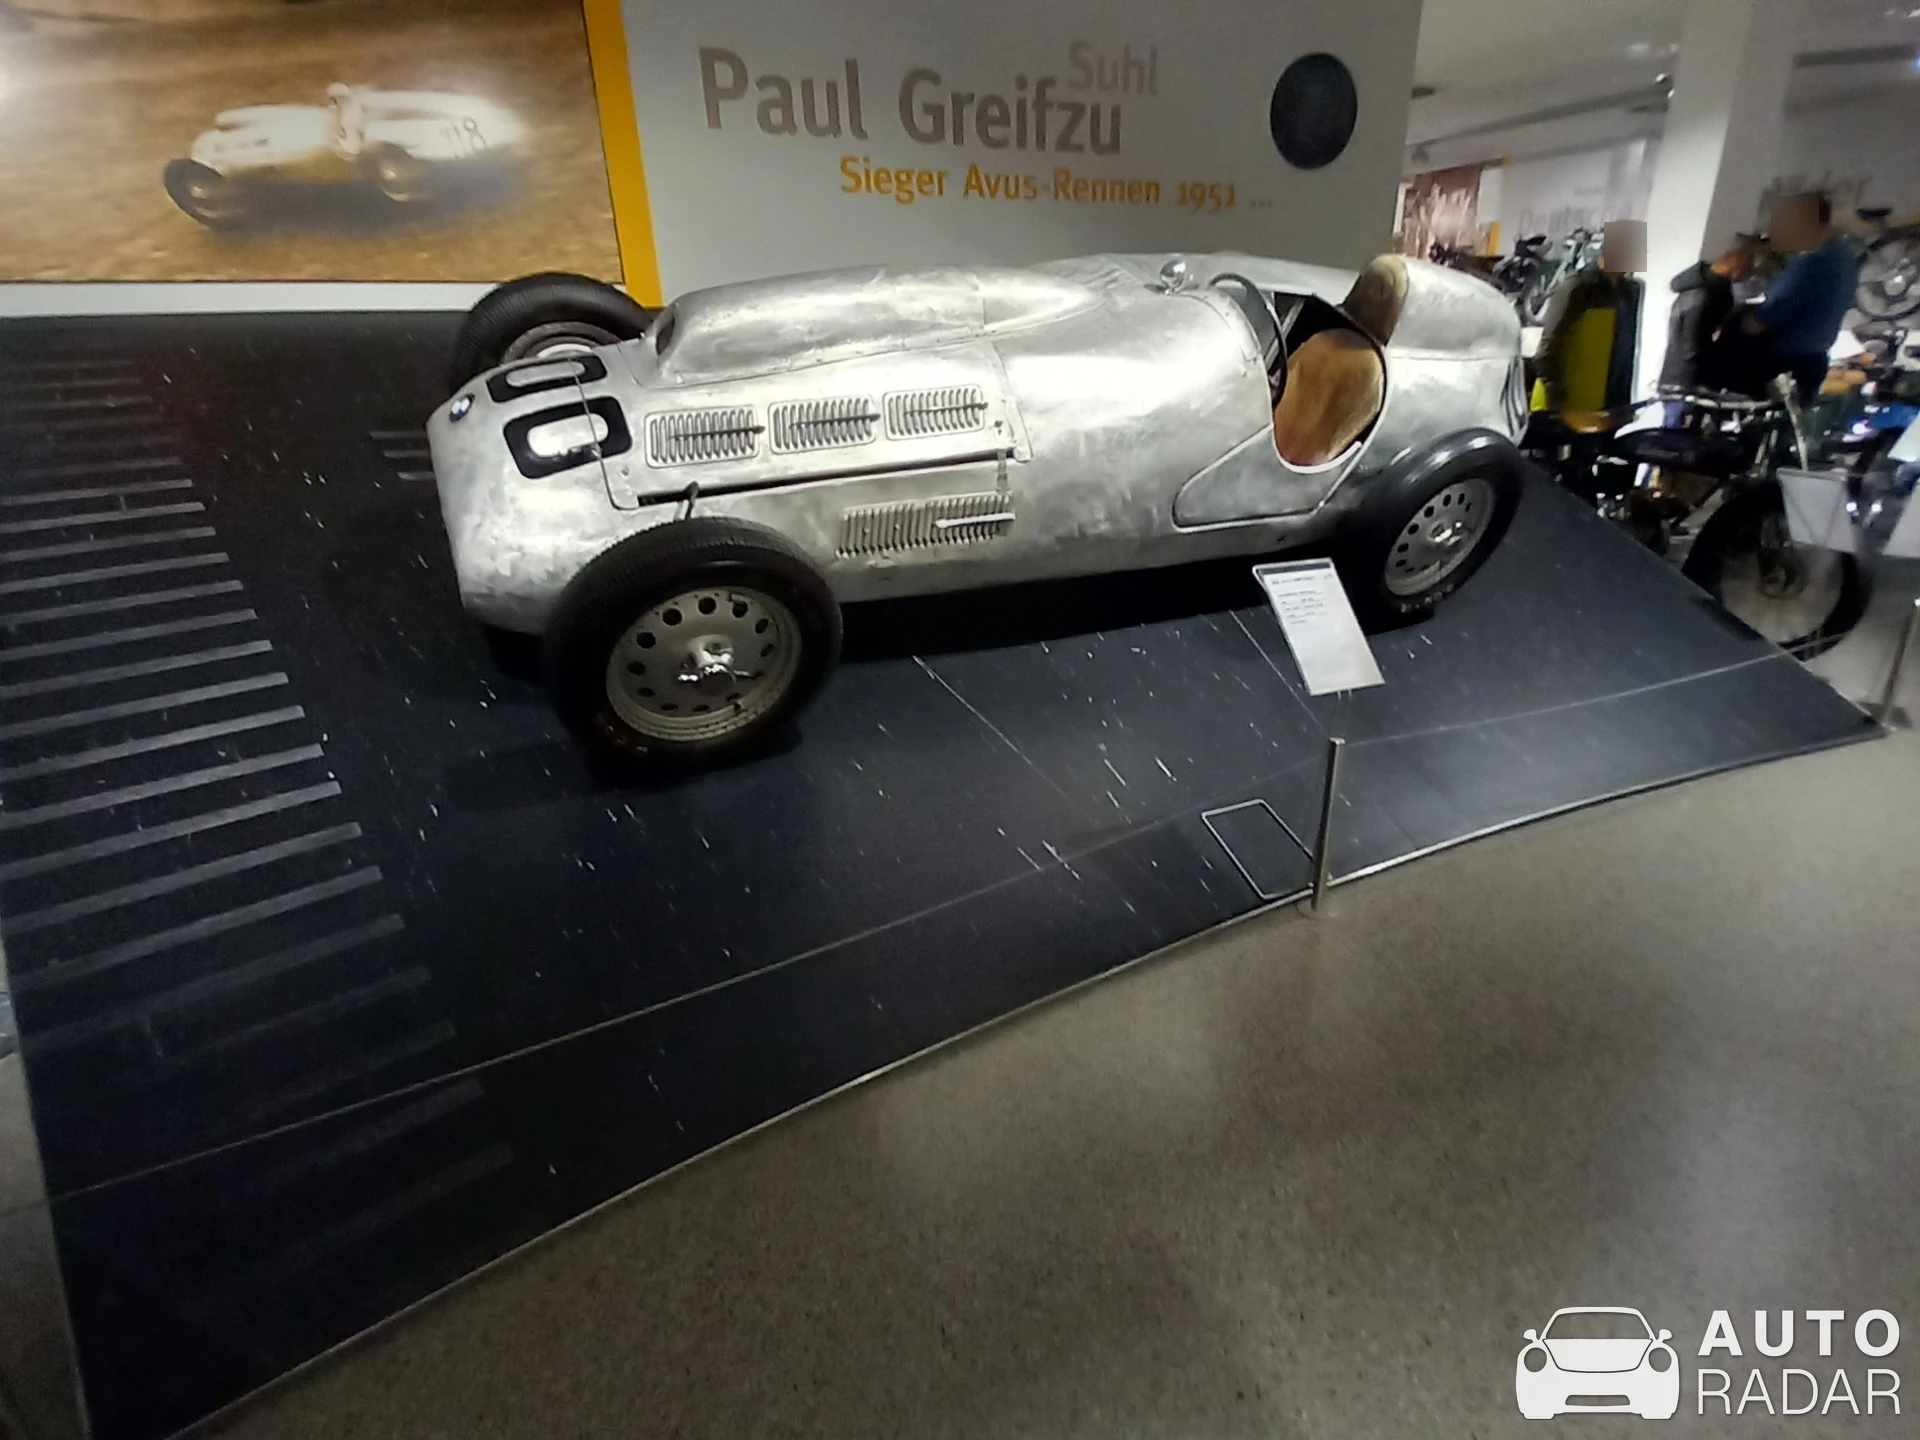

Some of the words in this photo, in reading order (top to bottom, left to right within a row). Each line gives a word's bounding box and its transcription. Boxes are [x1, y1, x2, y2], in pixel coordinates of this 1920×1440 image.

[1068, 39, 1158, 95] Suhl
[698, 47, 868, 140] Paul
[899, 68, 1121, 154] Greifzu
[840, 156, 948, 206] Sieger
[1177, 180, 1237, 214] 1951
